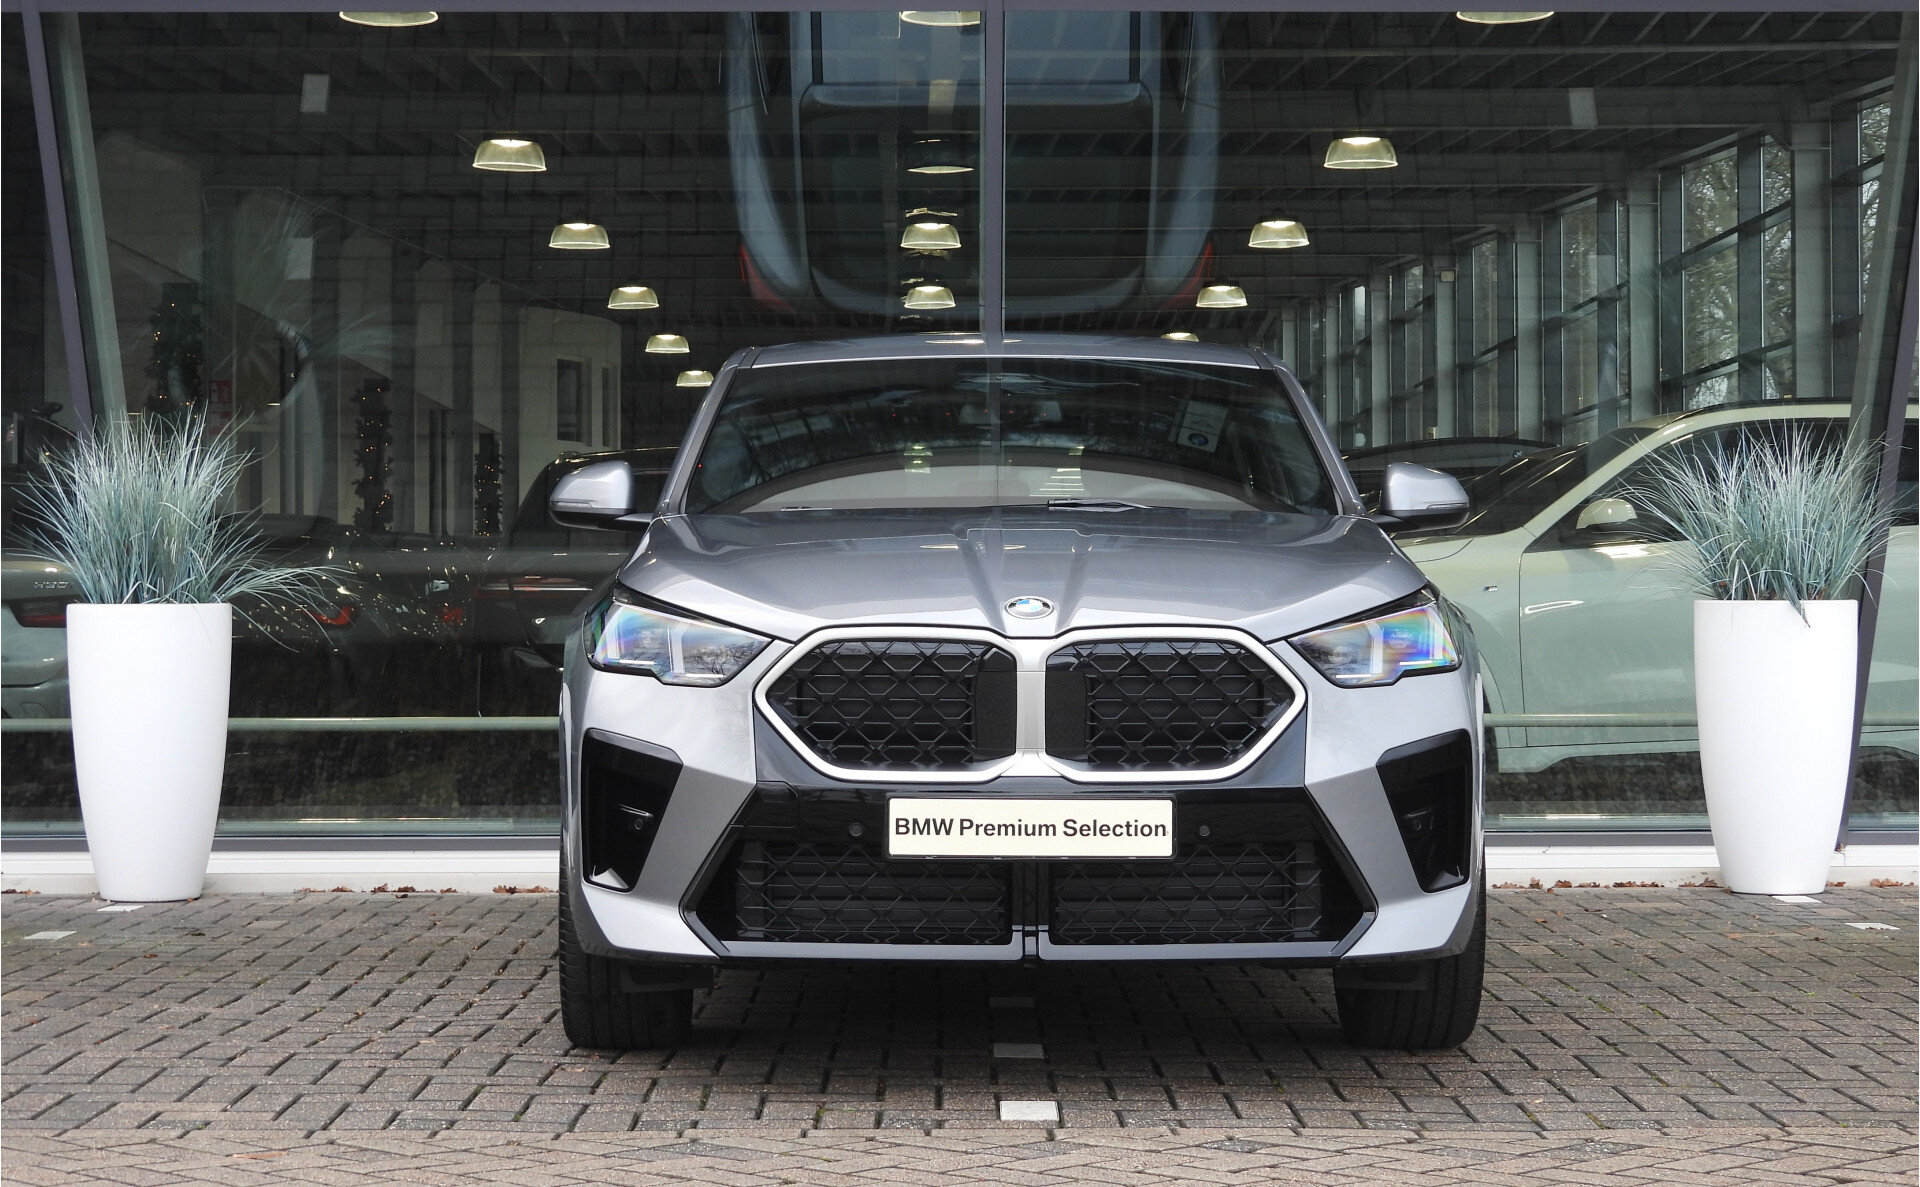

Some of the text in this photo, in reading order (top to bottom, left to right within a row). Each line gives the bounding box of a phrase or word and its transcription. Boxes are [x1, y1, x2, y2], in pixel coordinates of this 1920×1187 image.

[895, 818, 1167, 838] BMW Premium Selection
